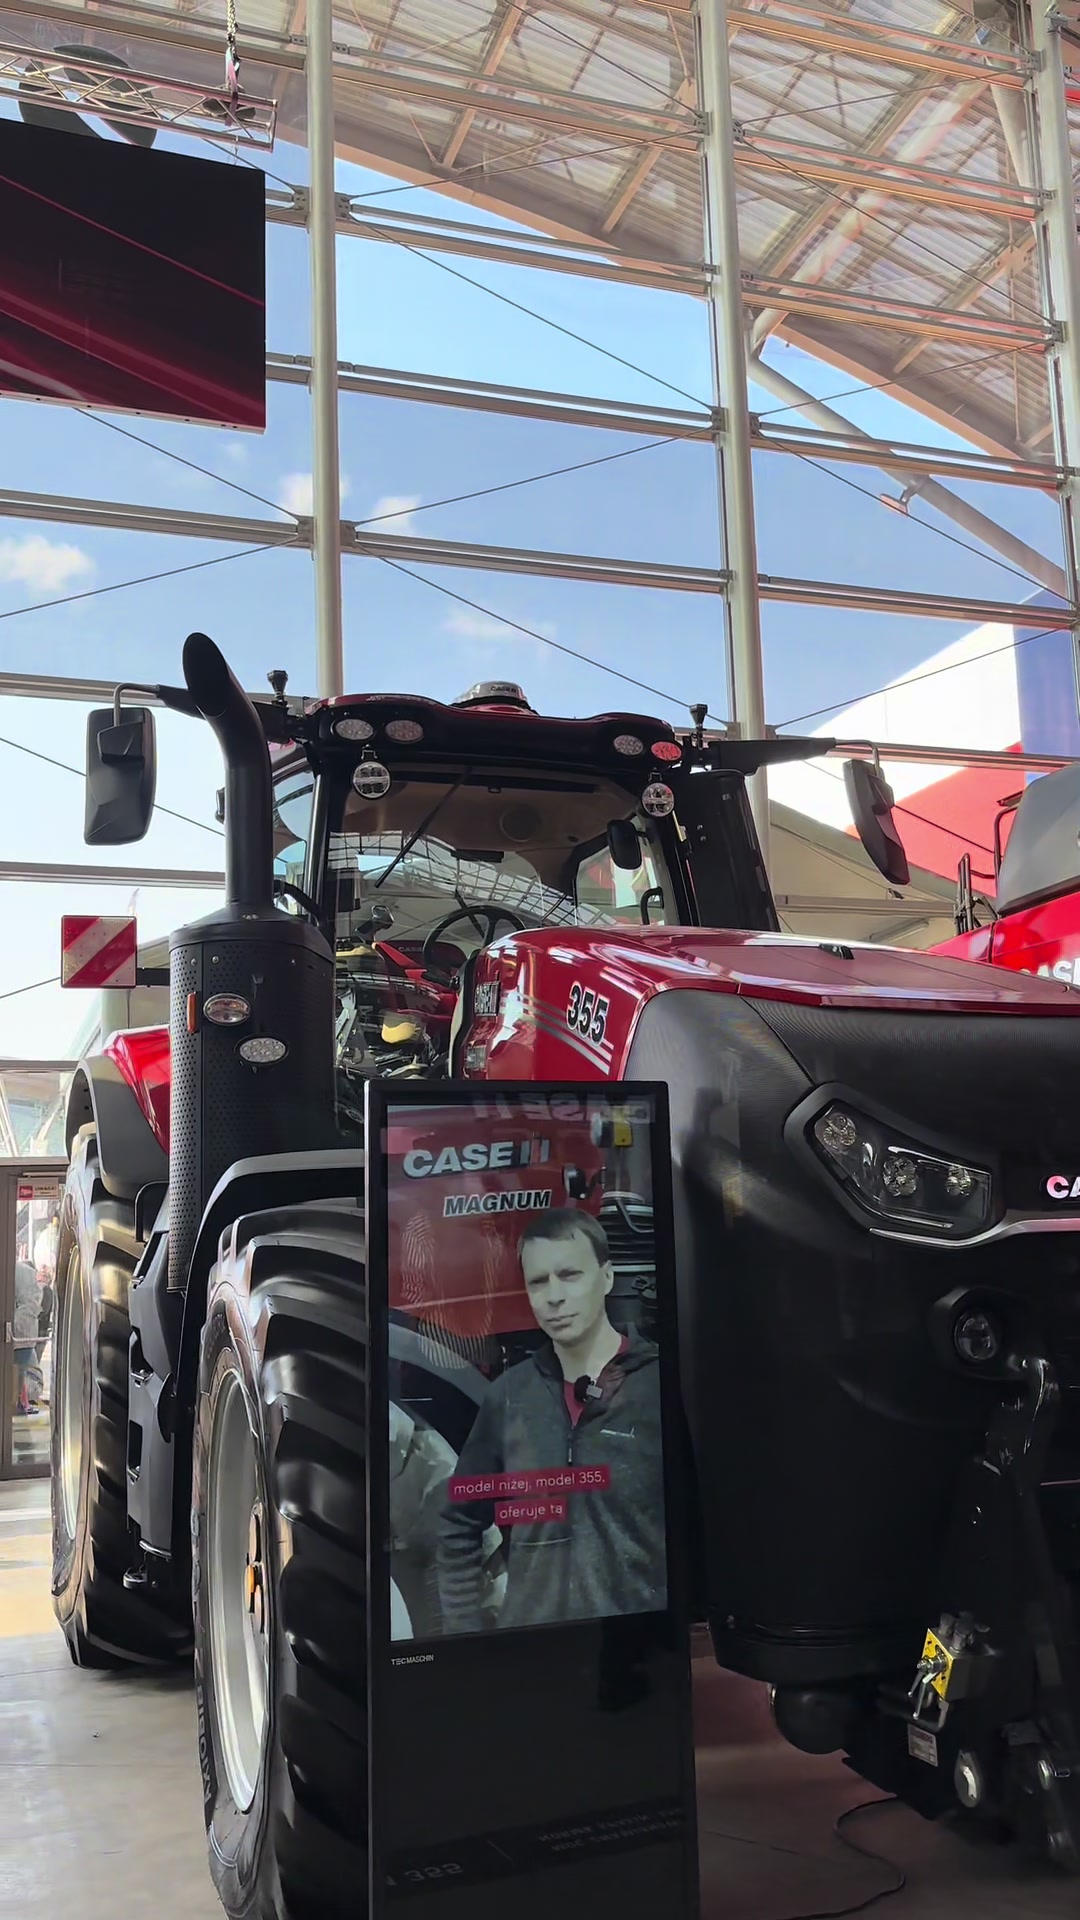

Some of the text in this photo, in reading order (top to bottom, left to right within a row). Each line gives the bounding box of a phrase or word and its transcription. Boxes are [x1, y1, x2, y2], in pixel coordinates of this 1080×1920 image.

[566, 980, 610, 1047] 355
[403, 1141, 514, 1178] CASE
[443, 1189, 552, 1218] MAGNUM
[454, 1480, 495, 1495] model
[536, 1473, 575, 1487] model
[499, 1505, 546, 1519] oferuje
